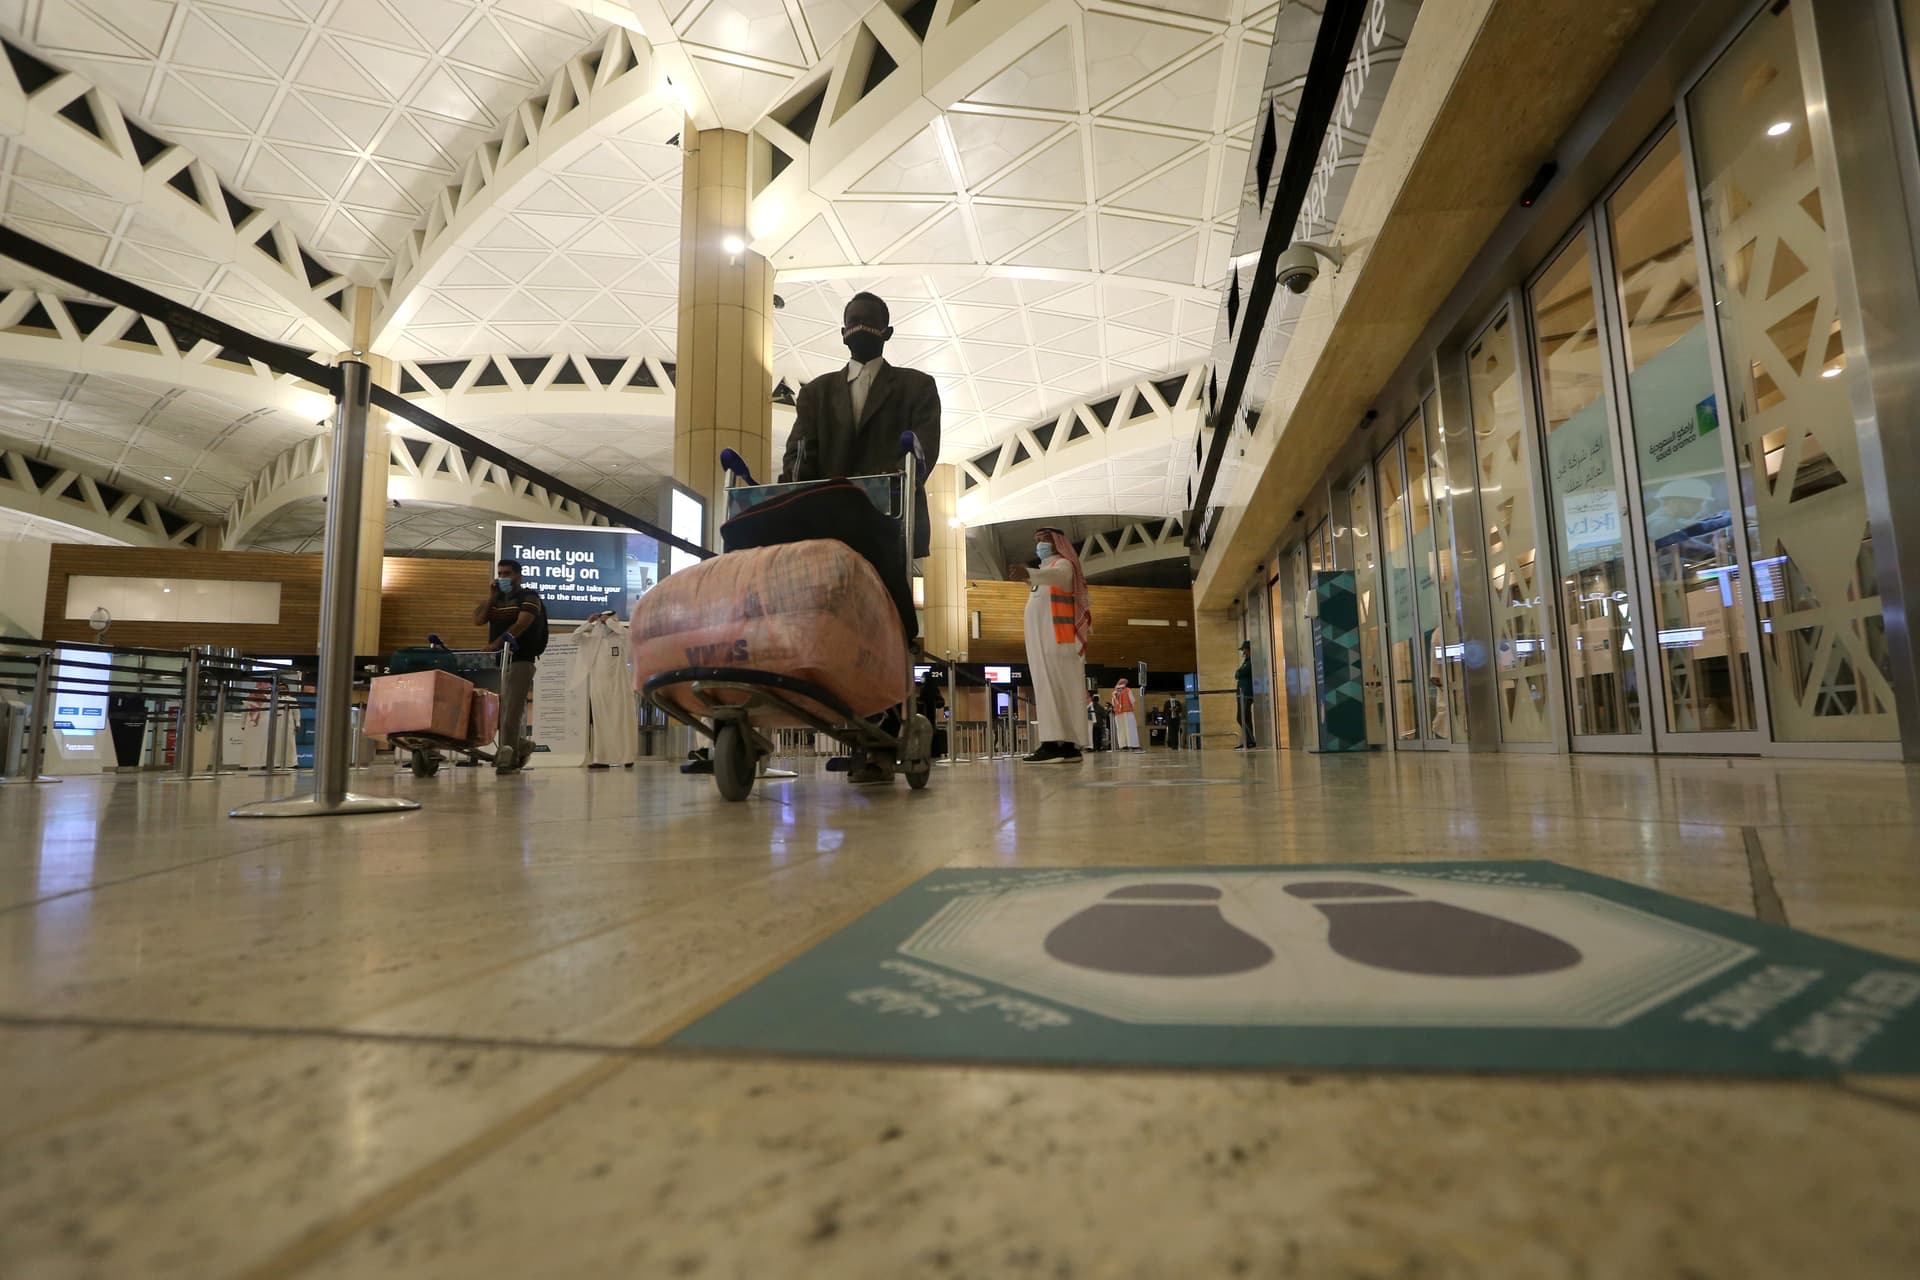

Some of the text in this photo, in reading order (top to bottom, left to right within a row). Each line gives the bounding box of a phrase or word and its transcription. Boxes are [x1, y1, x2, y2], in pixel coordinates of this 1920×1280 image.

[1672, 433, 1697, 453] aramco
[512, 545, 594, 565] Talent you
[520, 564, 600, 582] an rely on
[520, 581, 538, 589] skill
[539, 583, 557, 592] your
[558, 583, 575, 591] staff
[576, 584, 585, 592] to
[604, 586, 621, 594] your
[590, 595, 608, 603] level
